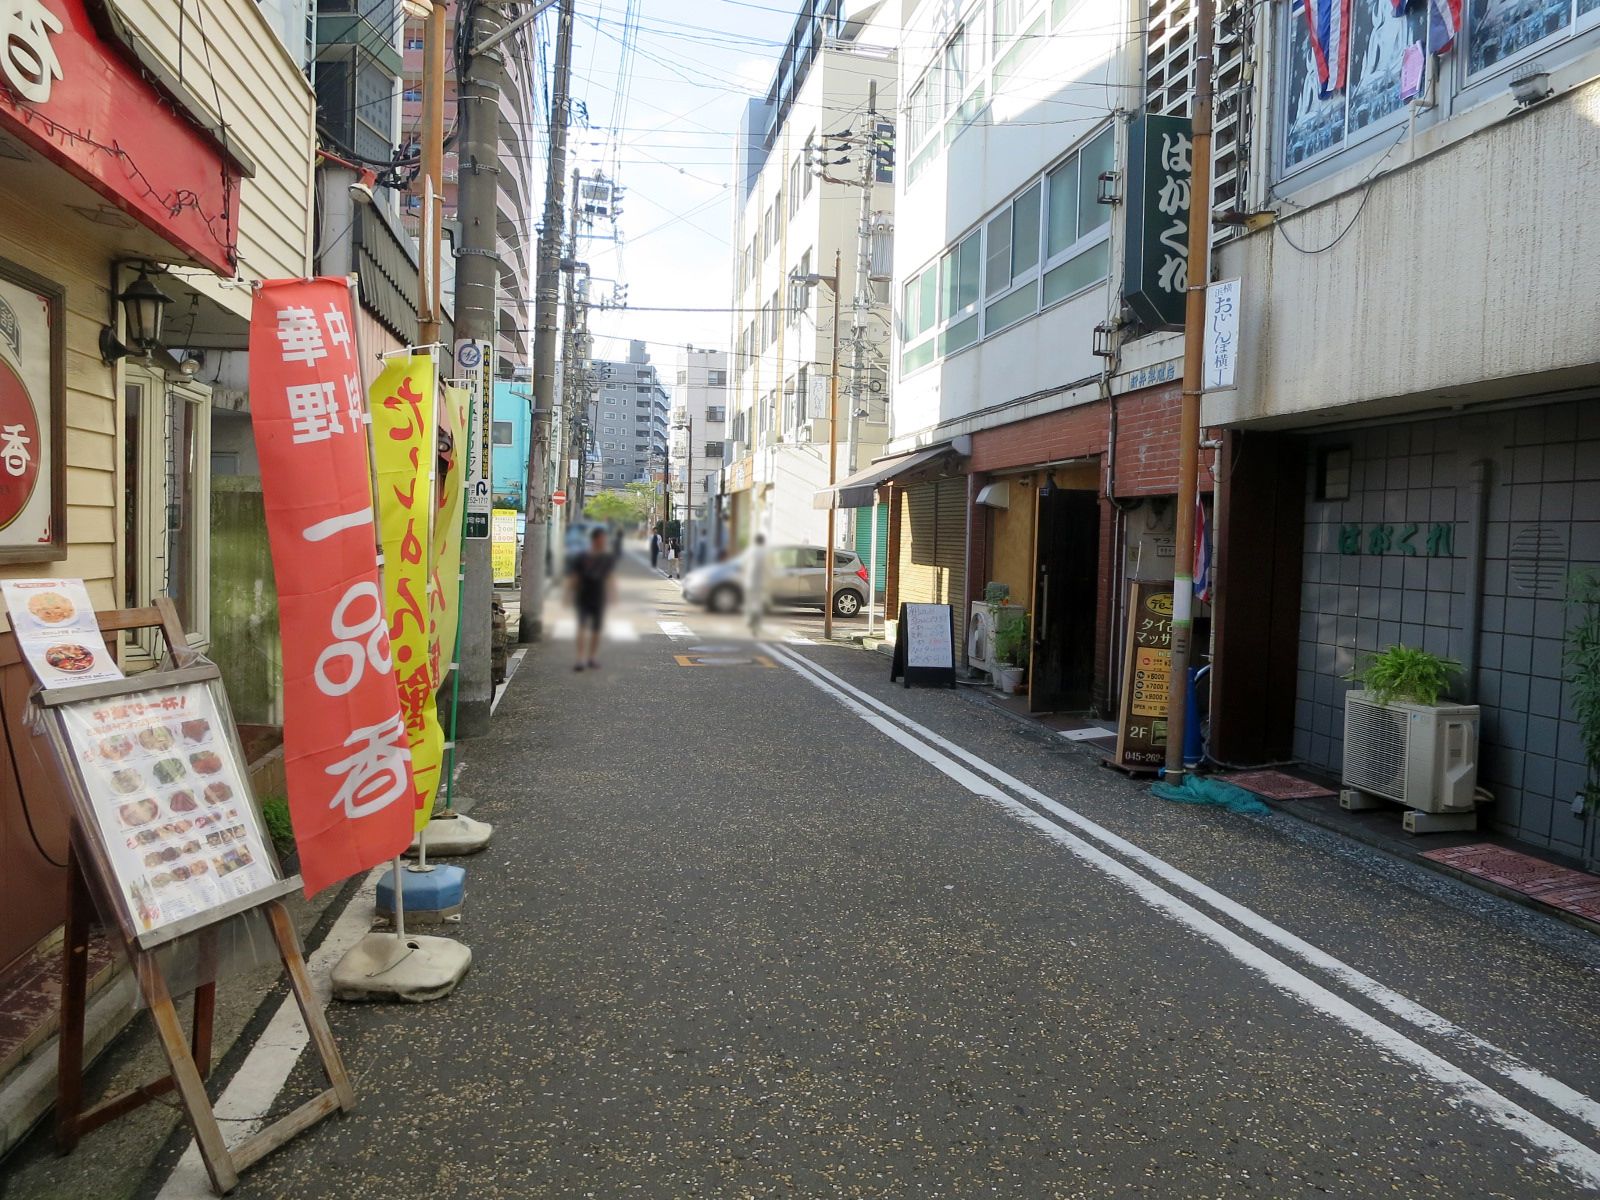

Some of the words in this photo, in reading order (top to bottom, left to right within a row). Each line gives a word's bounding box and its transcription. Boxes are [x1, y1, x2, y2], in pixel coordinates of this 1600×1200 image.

[1158, 132, 1194, 293] はがくれ
[1338, 523, 1453, 558] はがくれ
[1129, 726, 1149, 739] 2F
